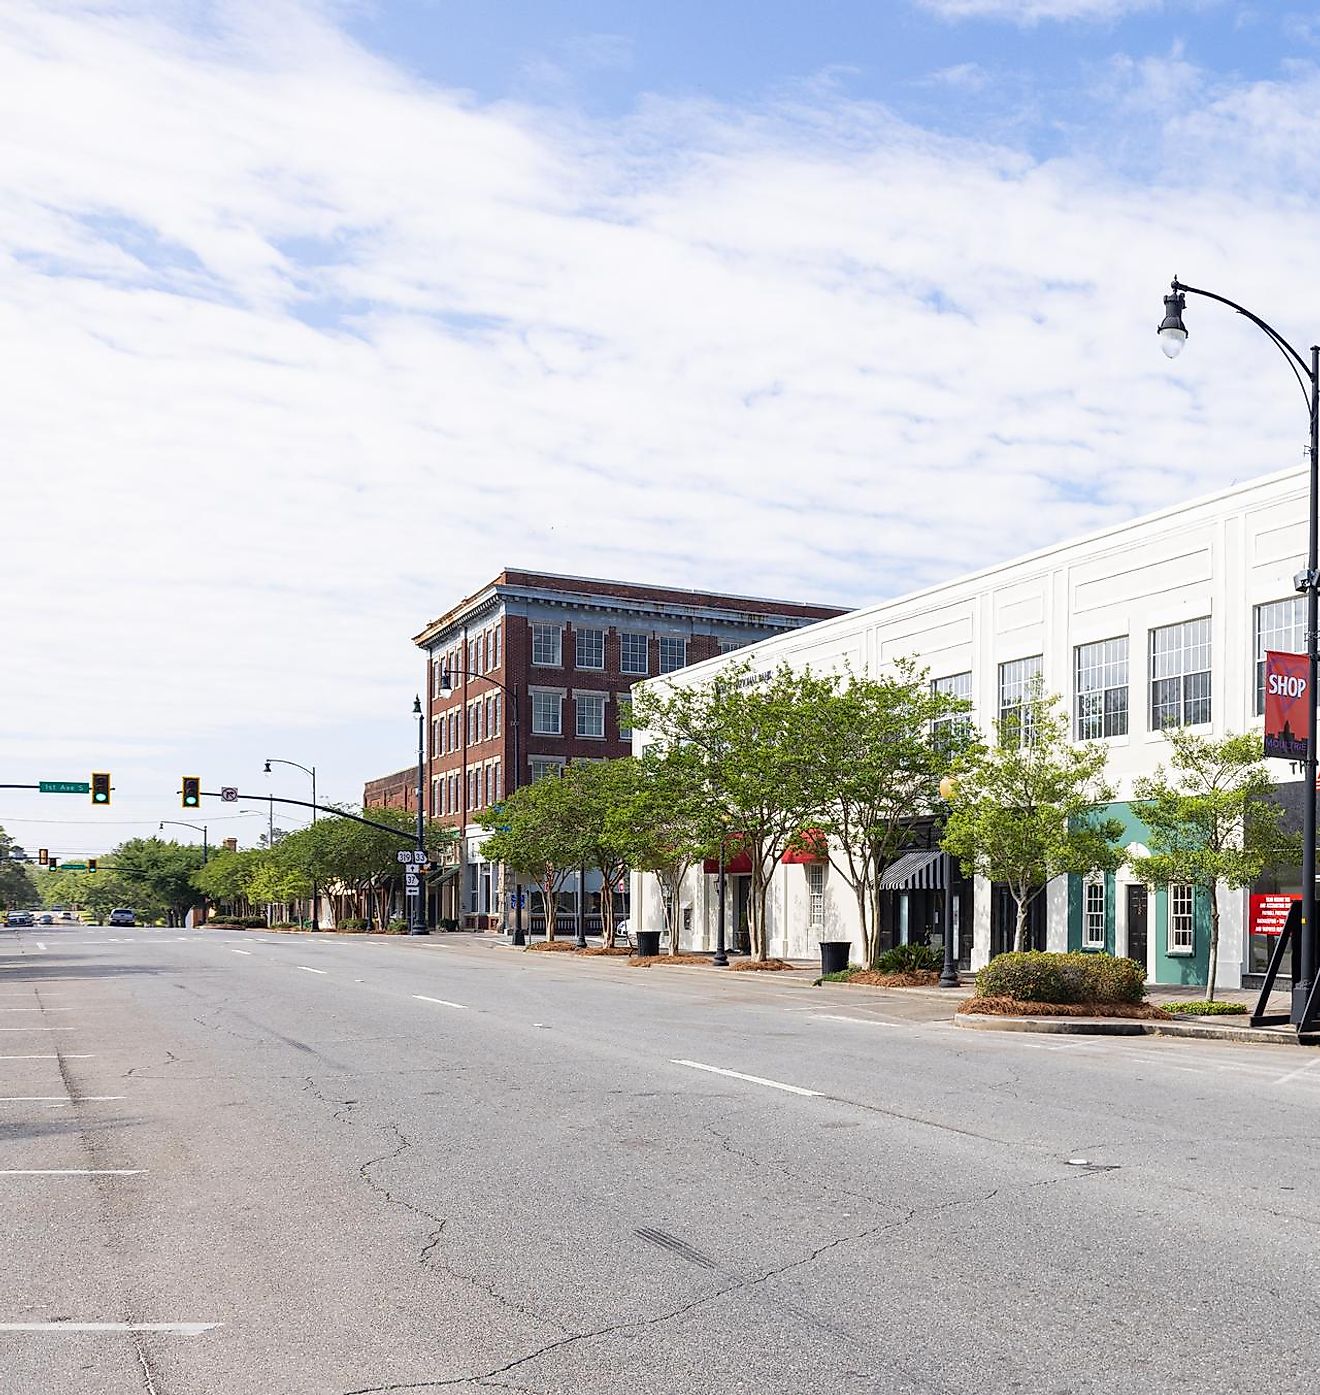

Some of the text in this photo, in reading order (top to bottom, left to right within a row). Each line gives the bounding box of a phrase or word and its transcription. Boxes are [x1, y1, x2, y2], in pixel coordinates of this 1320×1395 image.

[1268, 673, 1307, 698] SHOP
[399, 853, 411, 861] 319
[415, 853, 425, 861] 33
[407, 876, 416, 884] 37
